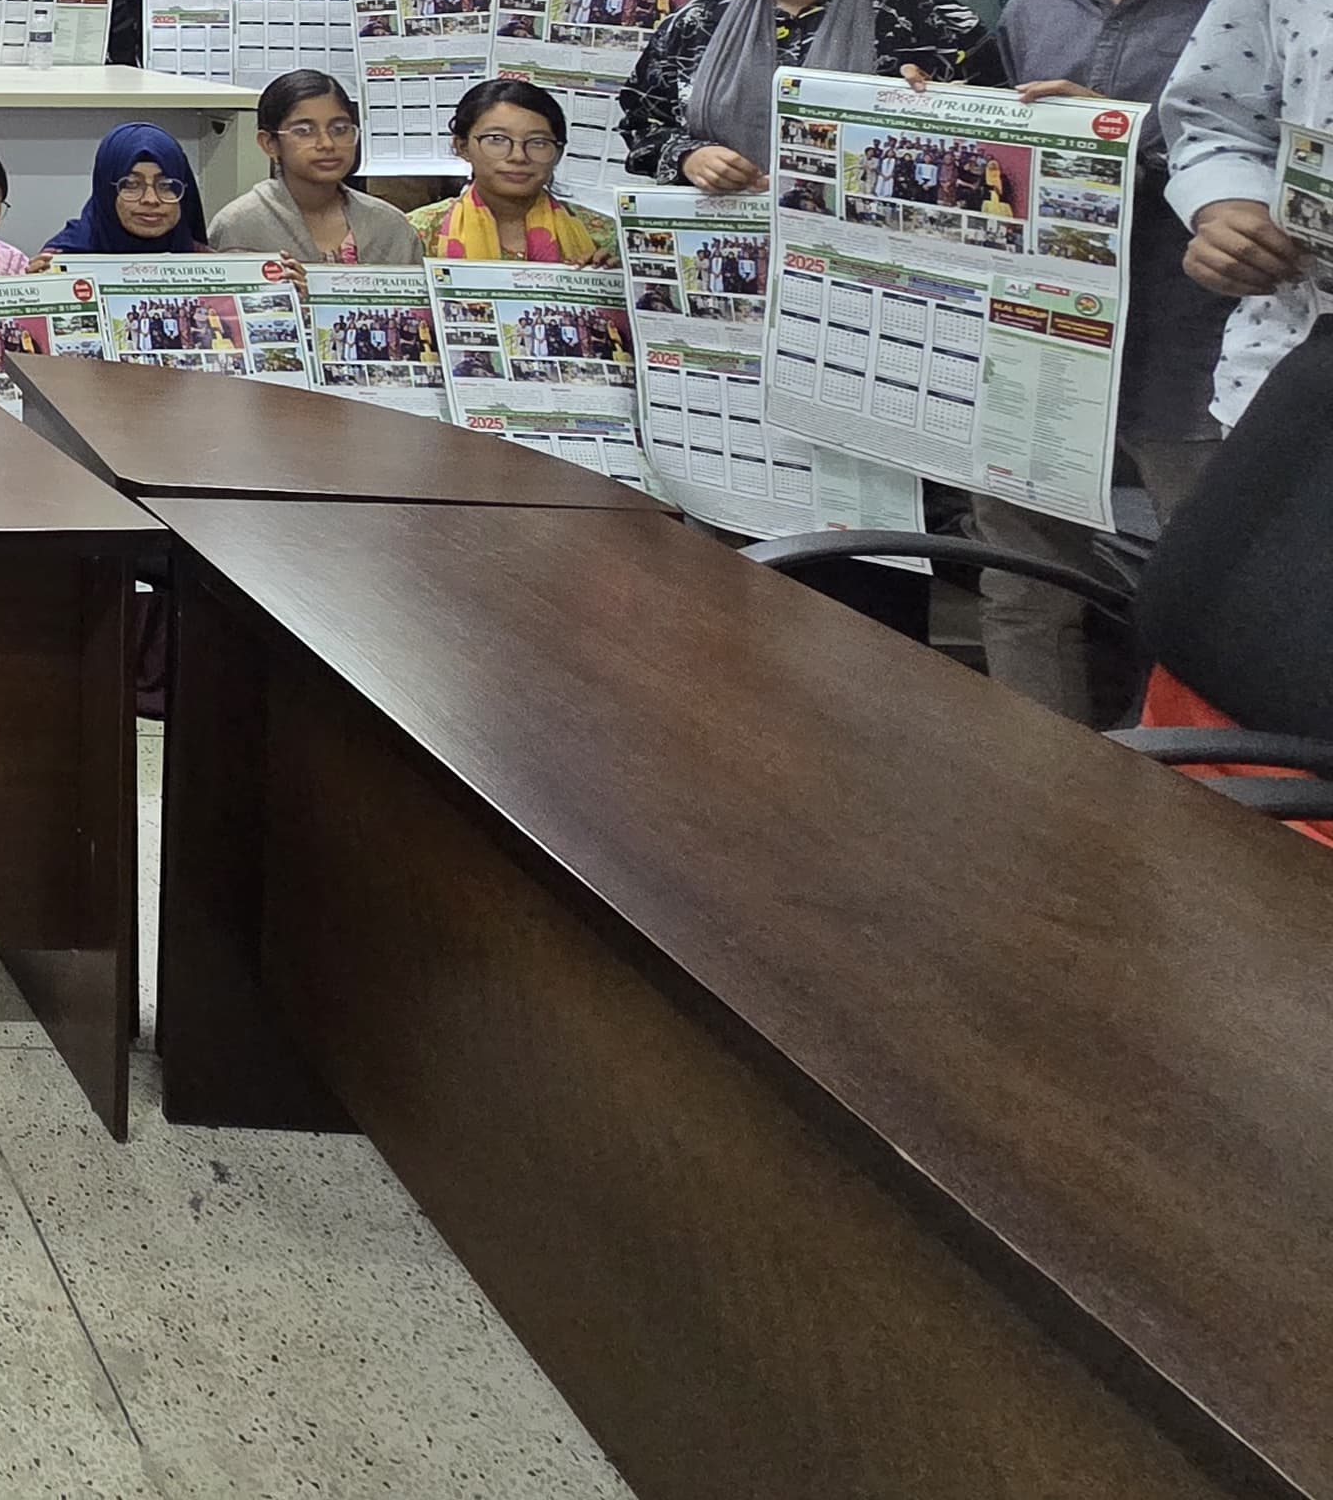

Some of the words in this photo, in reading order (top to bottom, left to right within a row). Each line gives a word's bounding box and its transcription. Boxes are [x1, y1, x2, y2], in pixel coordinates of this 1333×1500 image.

[931, 98, 1033, 121] (PRADHIKAR)
[1056, 137, 1098, 151] 3100
[785, 252, 825, 274] 2025
[647, 350, 680, 366] 2025
[467, 416, 504, 430] 2025
